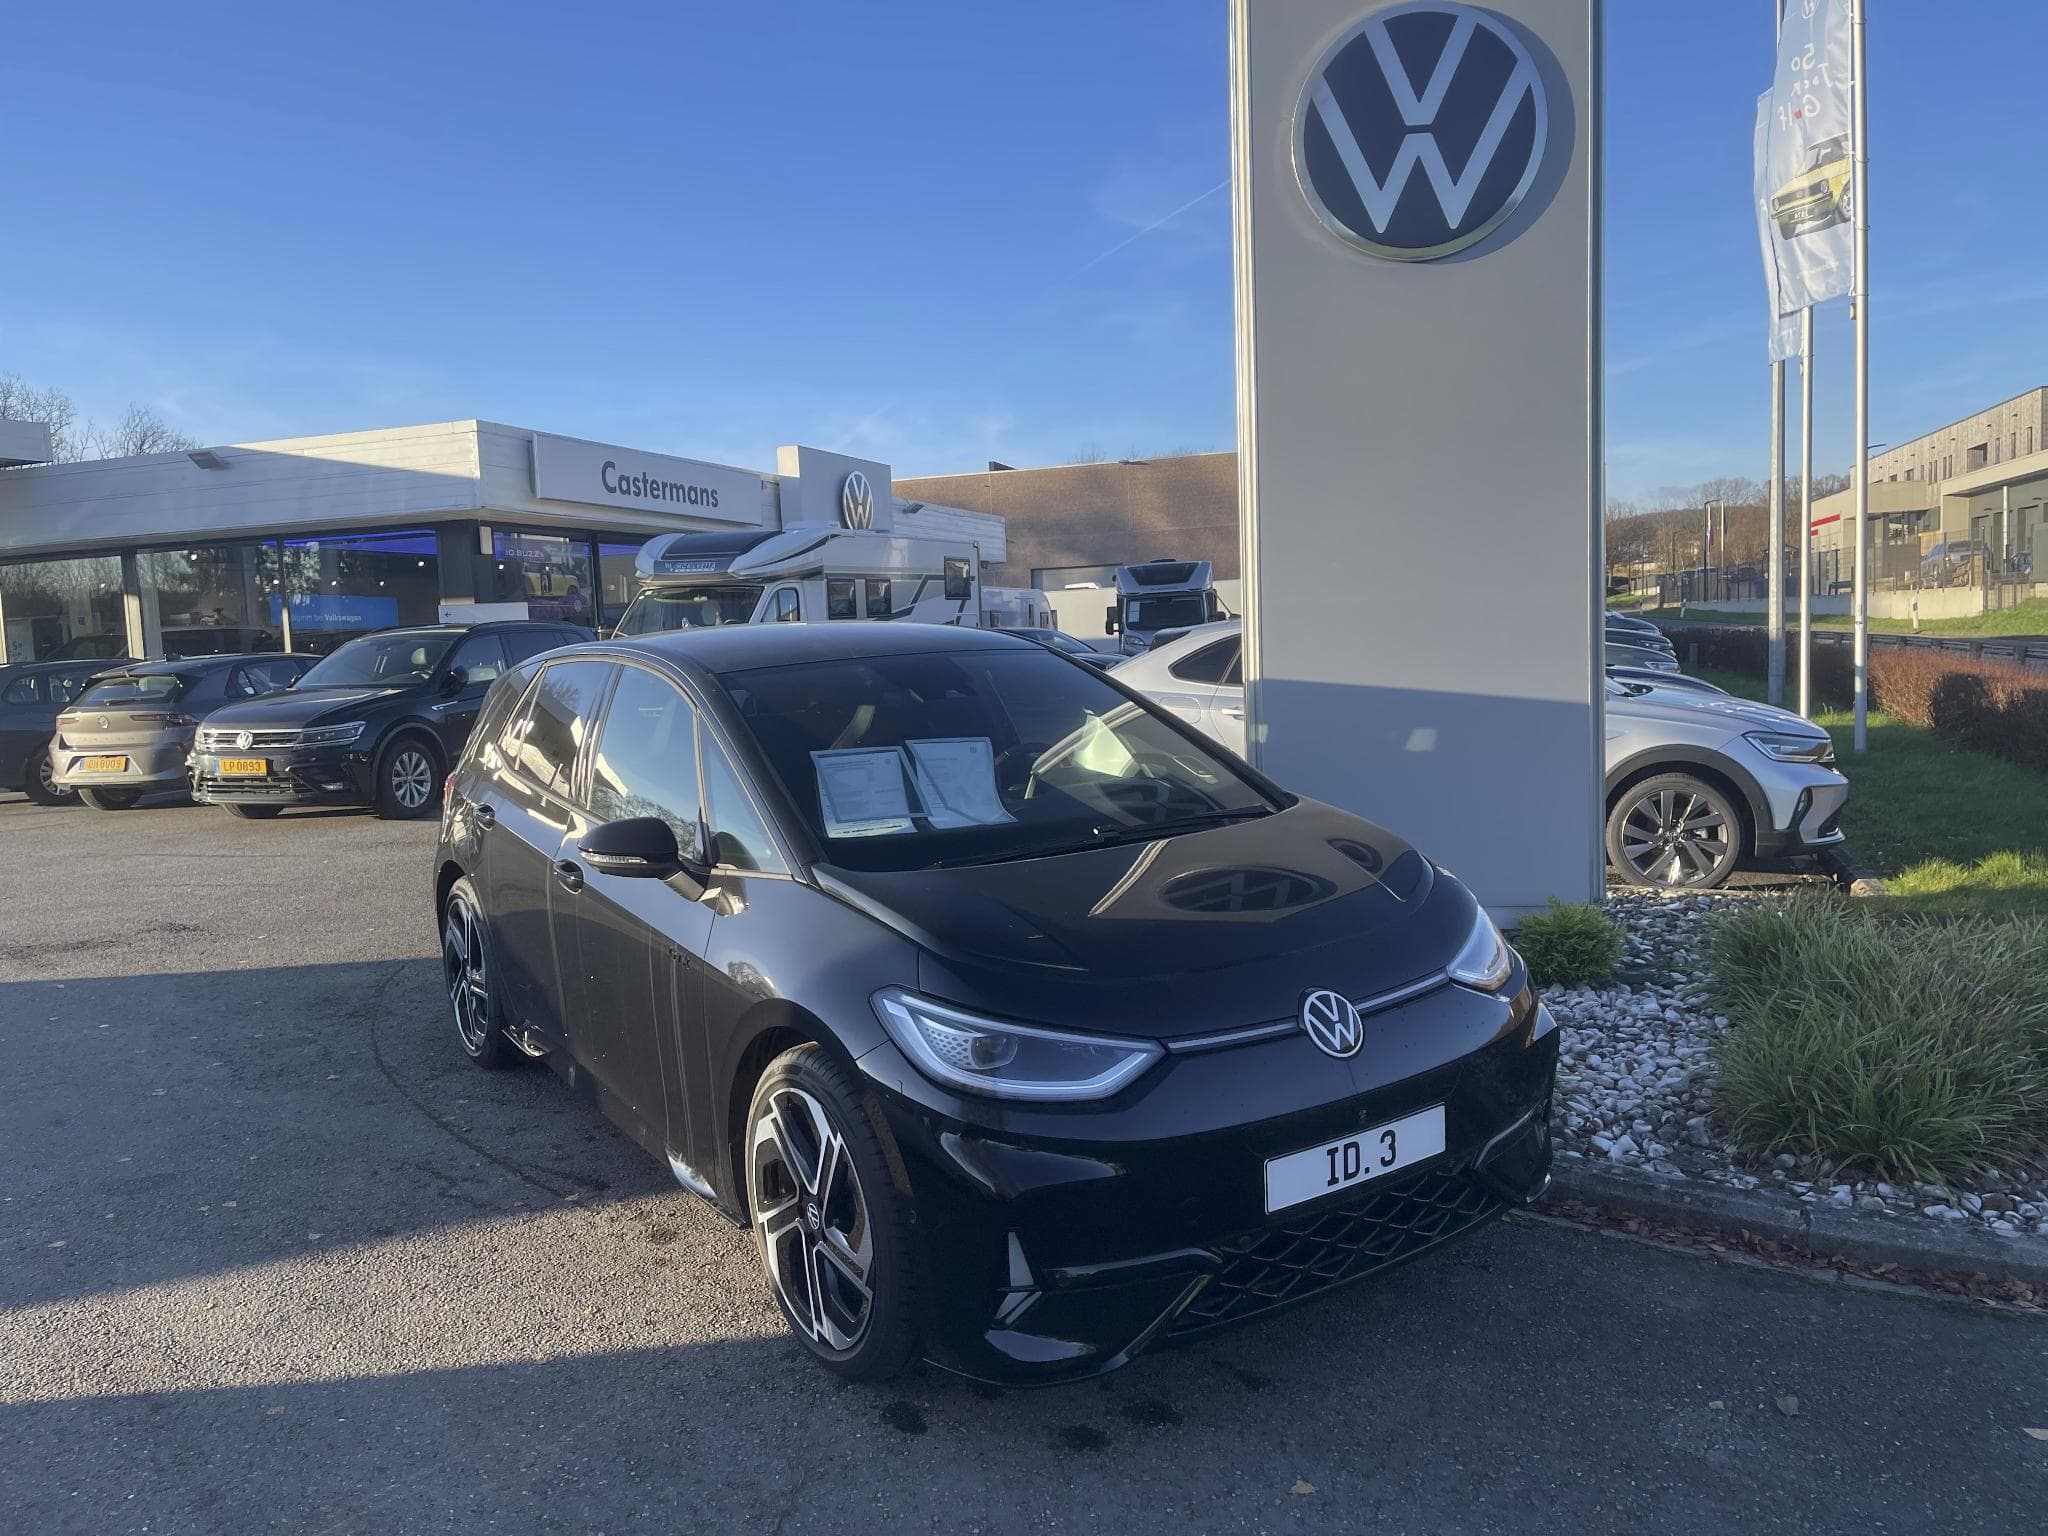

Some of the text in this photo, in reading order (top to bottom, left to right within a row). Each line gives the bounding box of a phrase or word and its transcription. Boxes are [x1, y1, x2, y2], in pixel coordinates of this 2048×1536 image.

[1309, 8, 1534, 234] VW
[601, 460, 719, 509] Castermans
[843, 471, 873, 529] VW
[324, 614, 362, 623] Volkswagen
[223, 761, 261, 772] LP 0893
[1304, 991, 1363, 1057] VW
[1326, 1129, 1397, 1187] ID. 3
